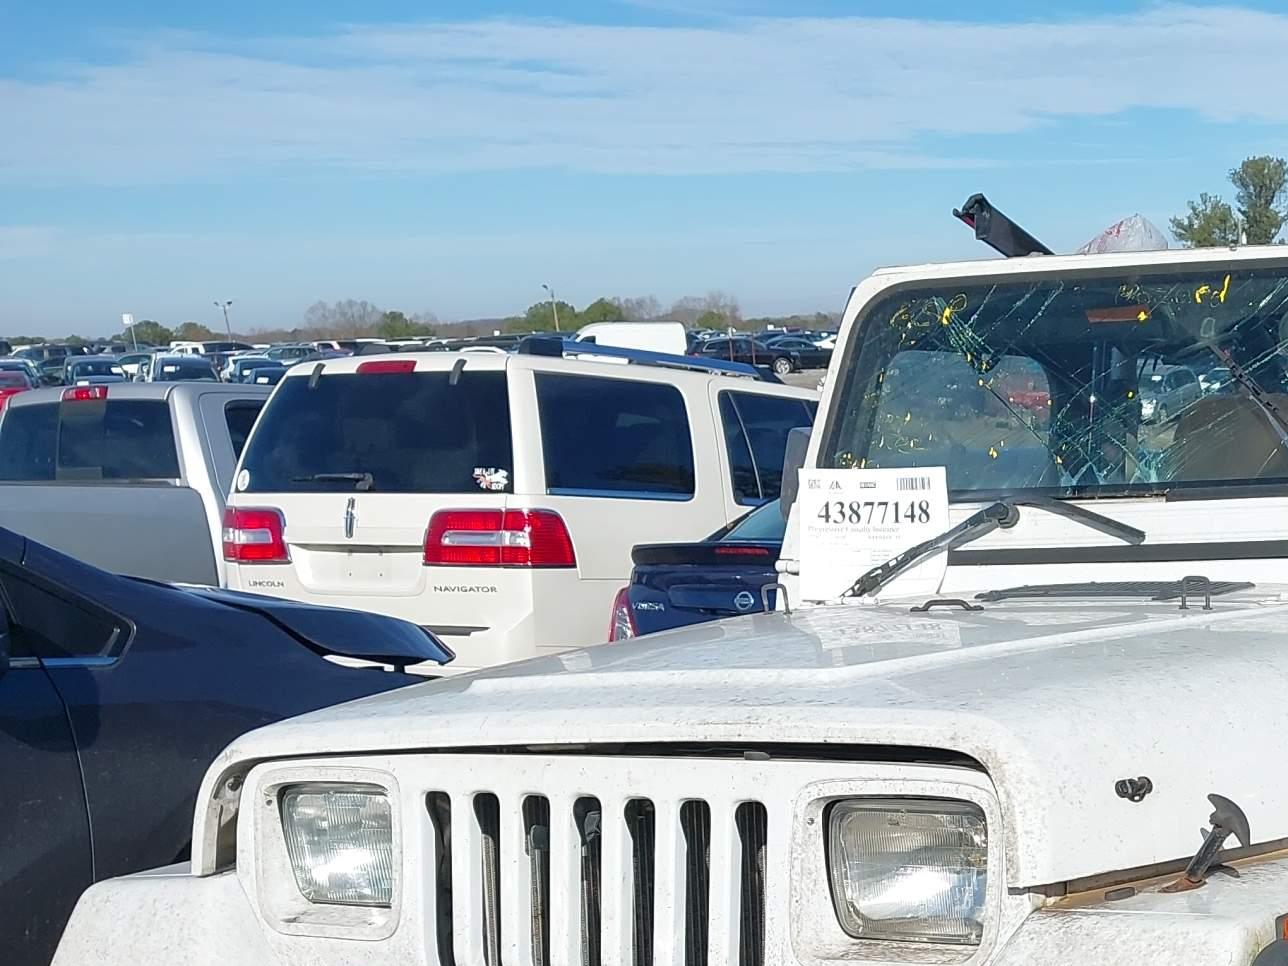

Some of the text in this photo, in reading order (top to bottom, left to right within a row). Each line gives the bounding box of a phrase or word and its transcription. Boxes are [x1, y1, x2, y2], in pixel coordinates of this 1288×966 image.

[817, 500, 931, 524] 43877148
[248, 579, 285, 588] LINCOLN
[433, 585, 498, 593] NAVIGATOR
